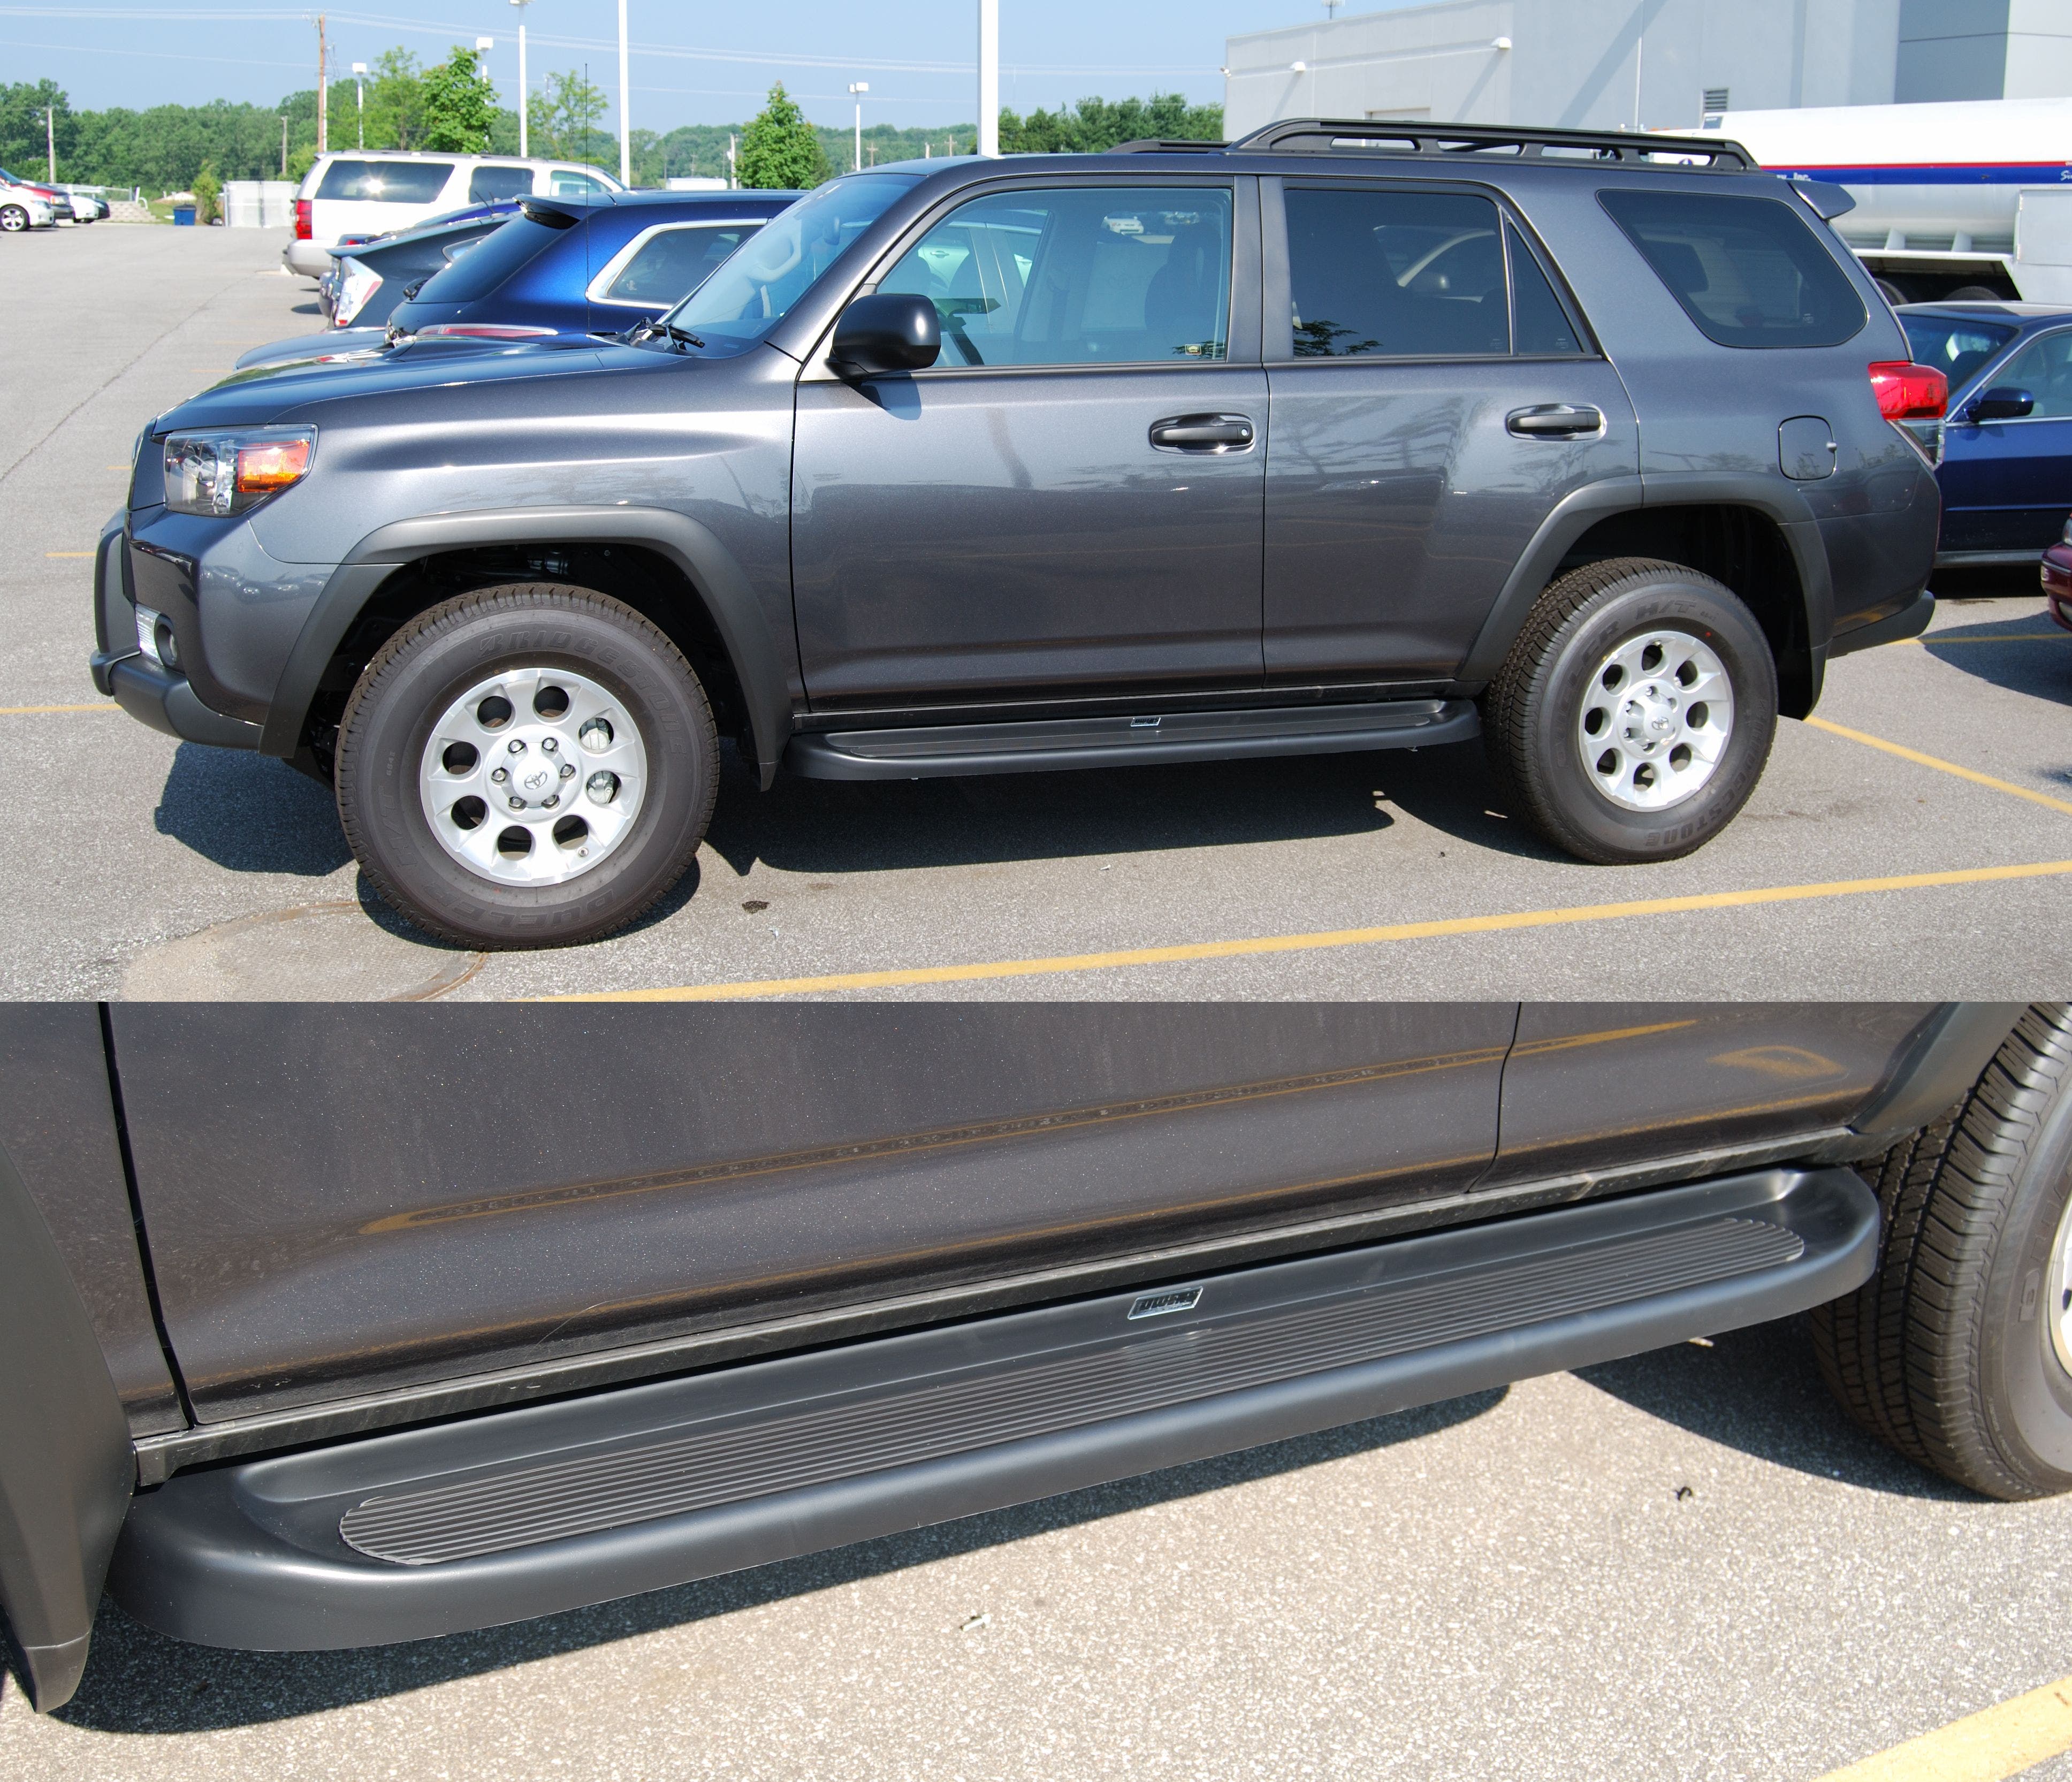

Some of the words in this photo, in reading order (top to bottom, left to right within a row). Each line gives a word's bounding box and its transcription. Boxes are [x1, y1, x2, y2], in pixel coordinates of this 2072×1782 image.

[1635, 599, 1697, 620] H/T
[478, 628, 687, 757] BRIDGESTONE
[422, 882, 616, 930] DUELER
